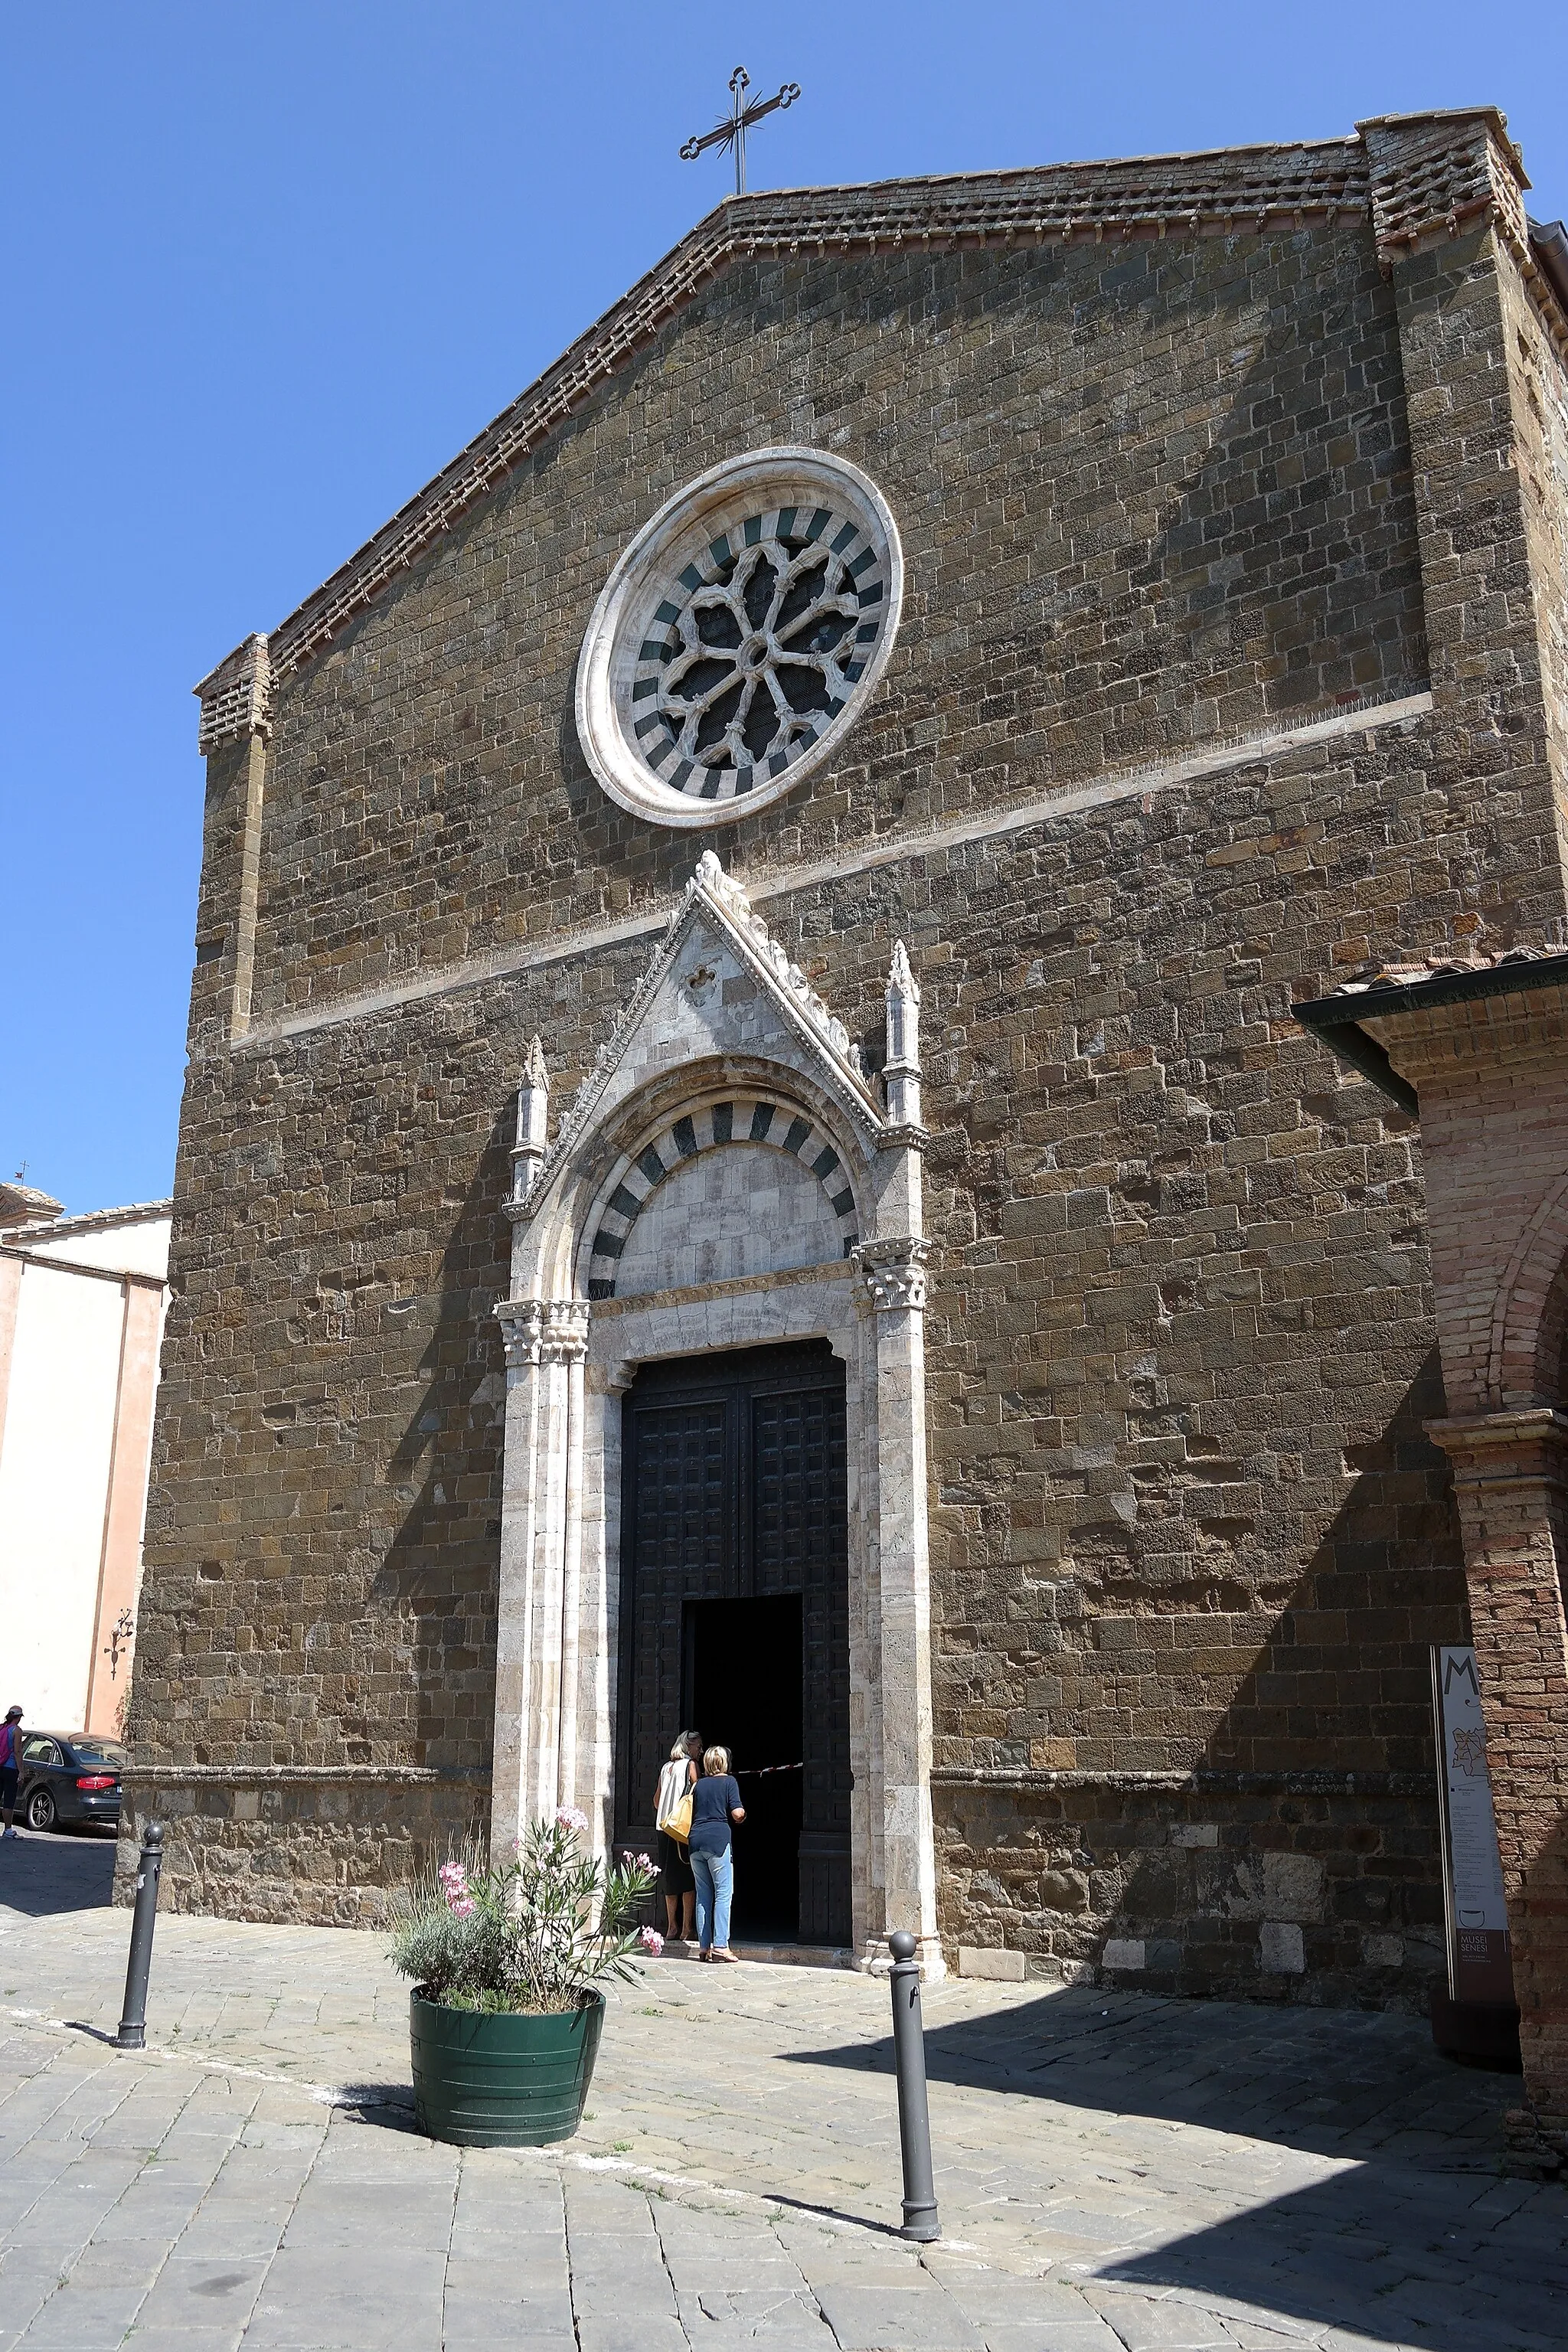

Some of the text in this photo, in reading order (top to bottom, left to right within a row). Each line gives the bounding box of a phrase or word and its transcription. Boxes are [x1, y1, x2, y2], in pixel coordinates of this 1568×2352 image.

[1444, 1655, 1479, 1695] M
[1461, 1936, 1488, 1944] MUSEI
[1461, 1943, 1488, 1952] SENESI
